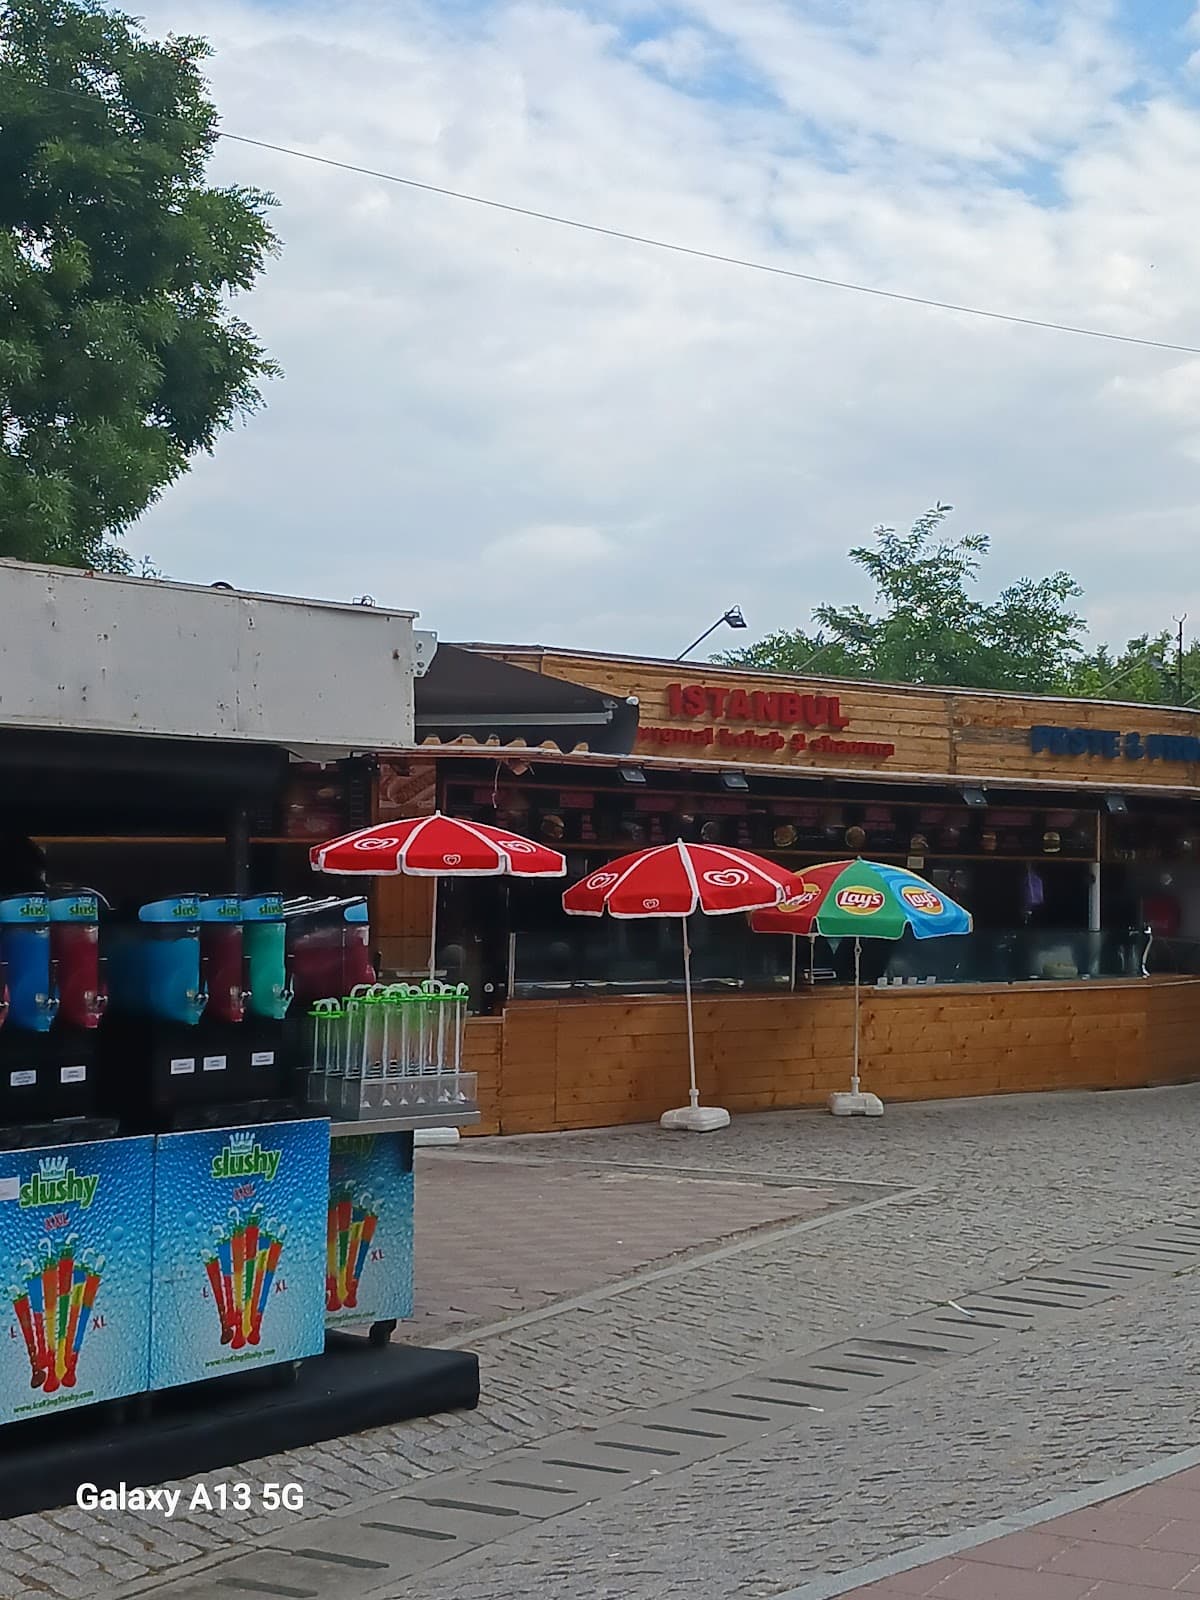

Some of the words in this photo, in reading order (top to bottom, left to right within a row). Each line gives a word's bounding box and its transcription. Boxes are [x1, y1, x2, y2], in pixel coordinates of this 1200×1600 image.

[667, 683, 849, 728] ISTANBUL
[839, 890, 882, 908] Lay's
[905, 890, 937, 908] Lay's
[212, 1144, 281, 1181] slushy
[20, 1169, 98, 1208] slushy
[274, 1281, 288, 1294] XL
[92, 1315, 107, 1331] XL
